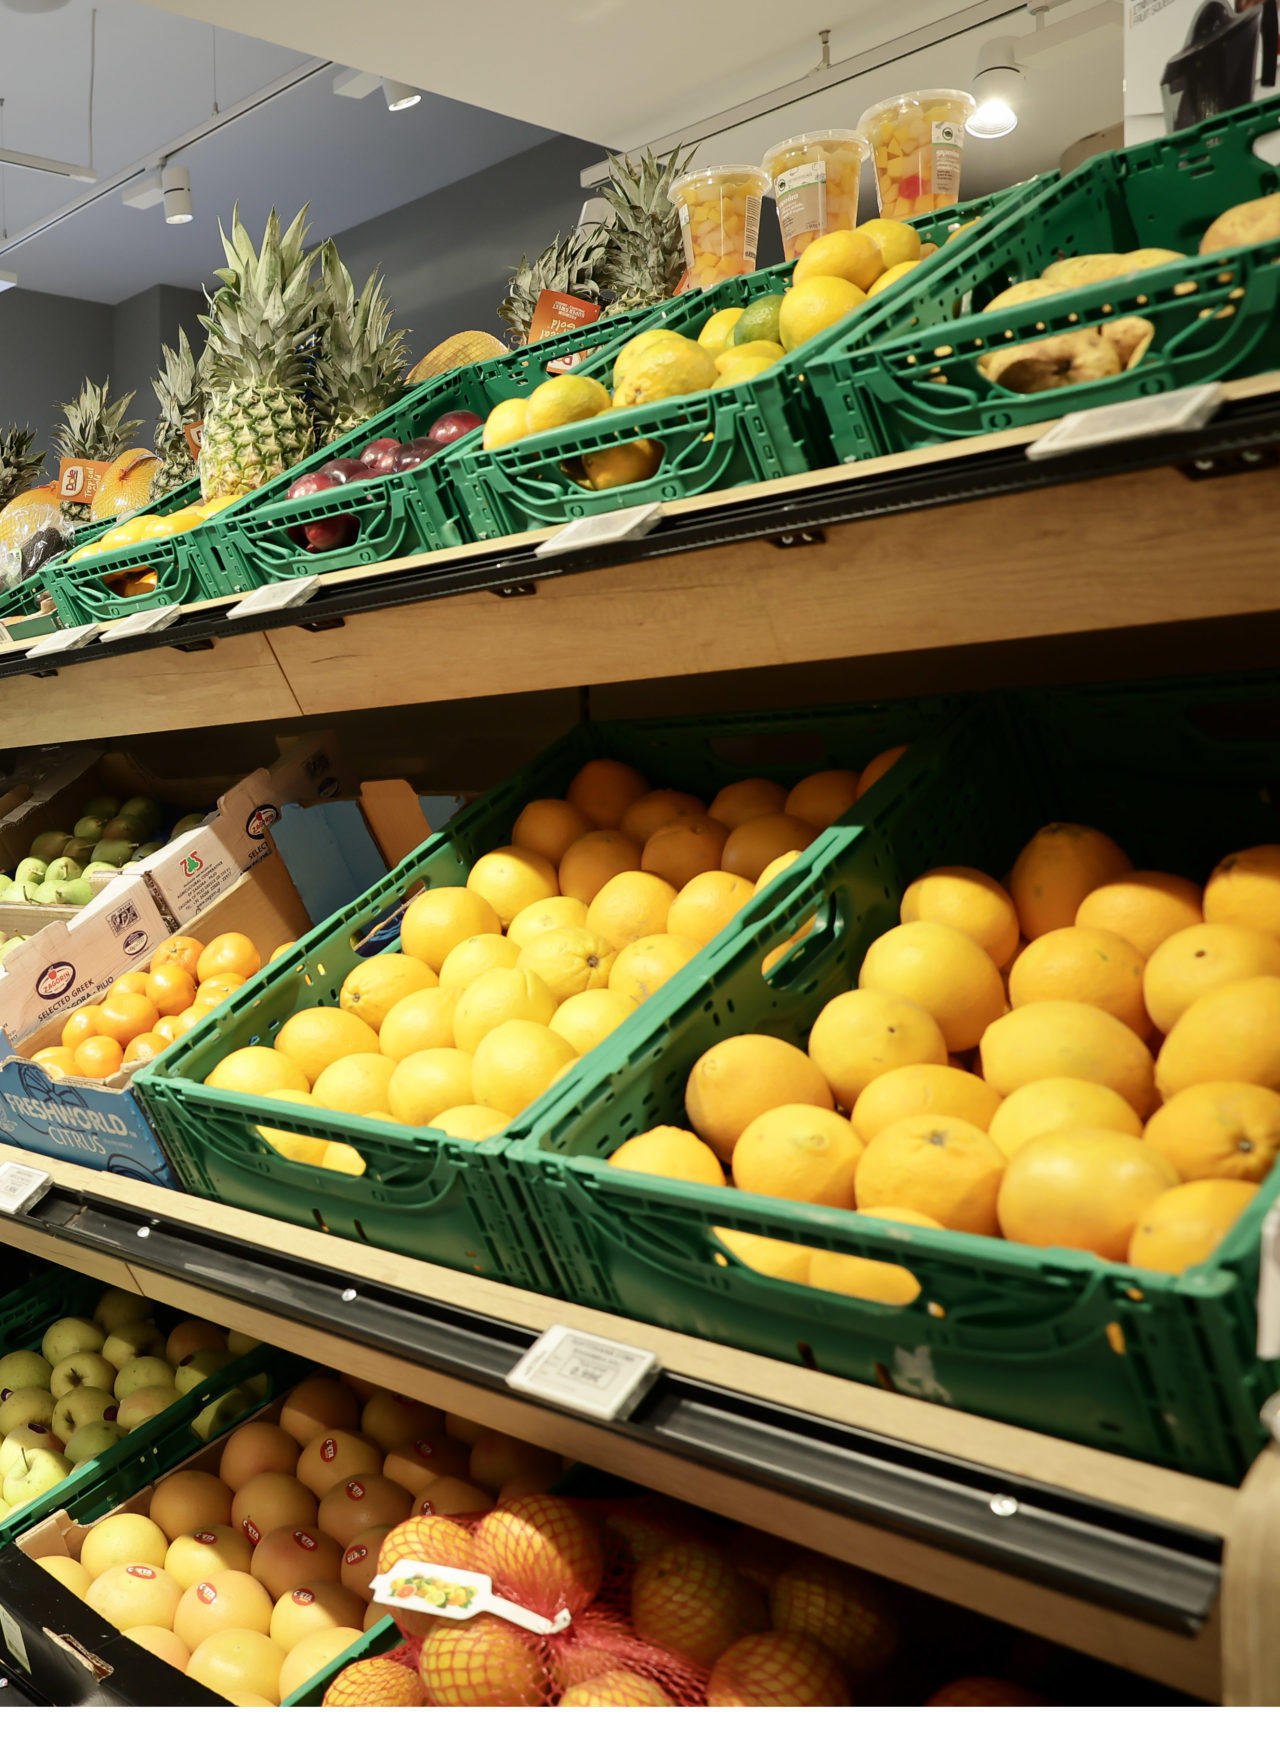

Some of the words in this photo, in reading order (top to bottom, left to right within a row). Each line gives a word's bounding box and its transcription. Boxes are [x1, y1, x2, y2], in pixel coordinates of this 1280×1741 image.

[65, 469, 79, 491] Dole
[84, 466, 95, 498] Tropical
[43, 971, 71, 993] ZAGORIN
[96, 976, 114, 992] PILIO
[37, 995, 70, 1022] SELECTED
[71, 978, 95, 998] GREEK
[4, 1093, 128, 1136] FRESHWORLD
[48, 1126, 106, 1155] CITRUS
